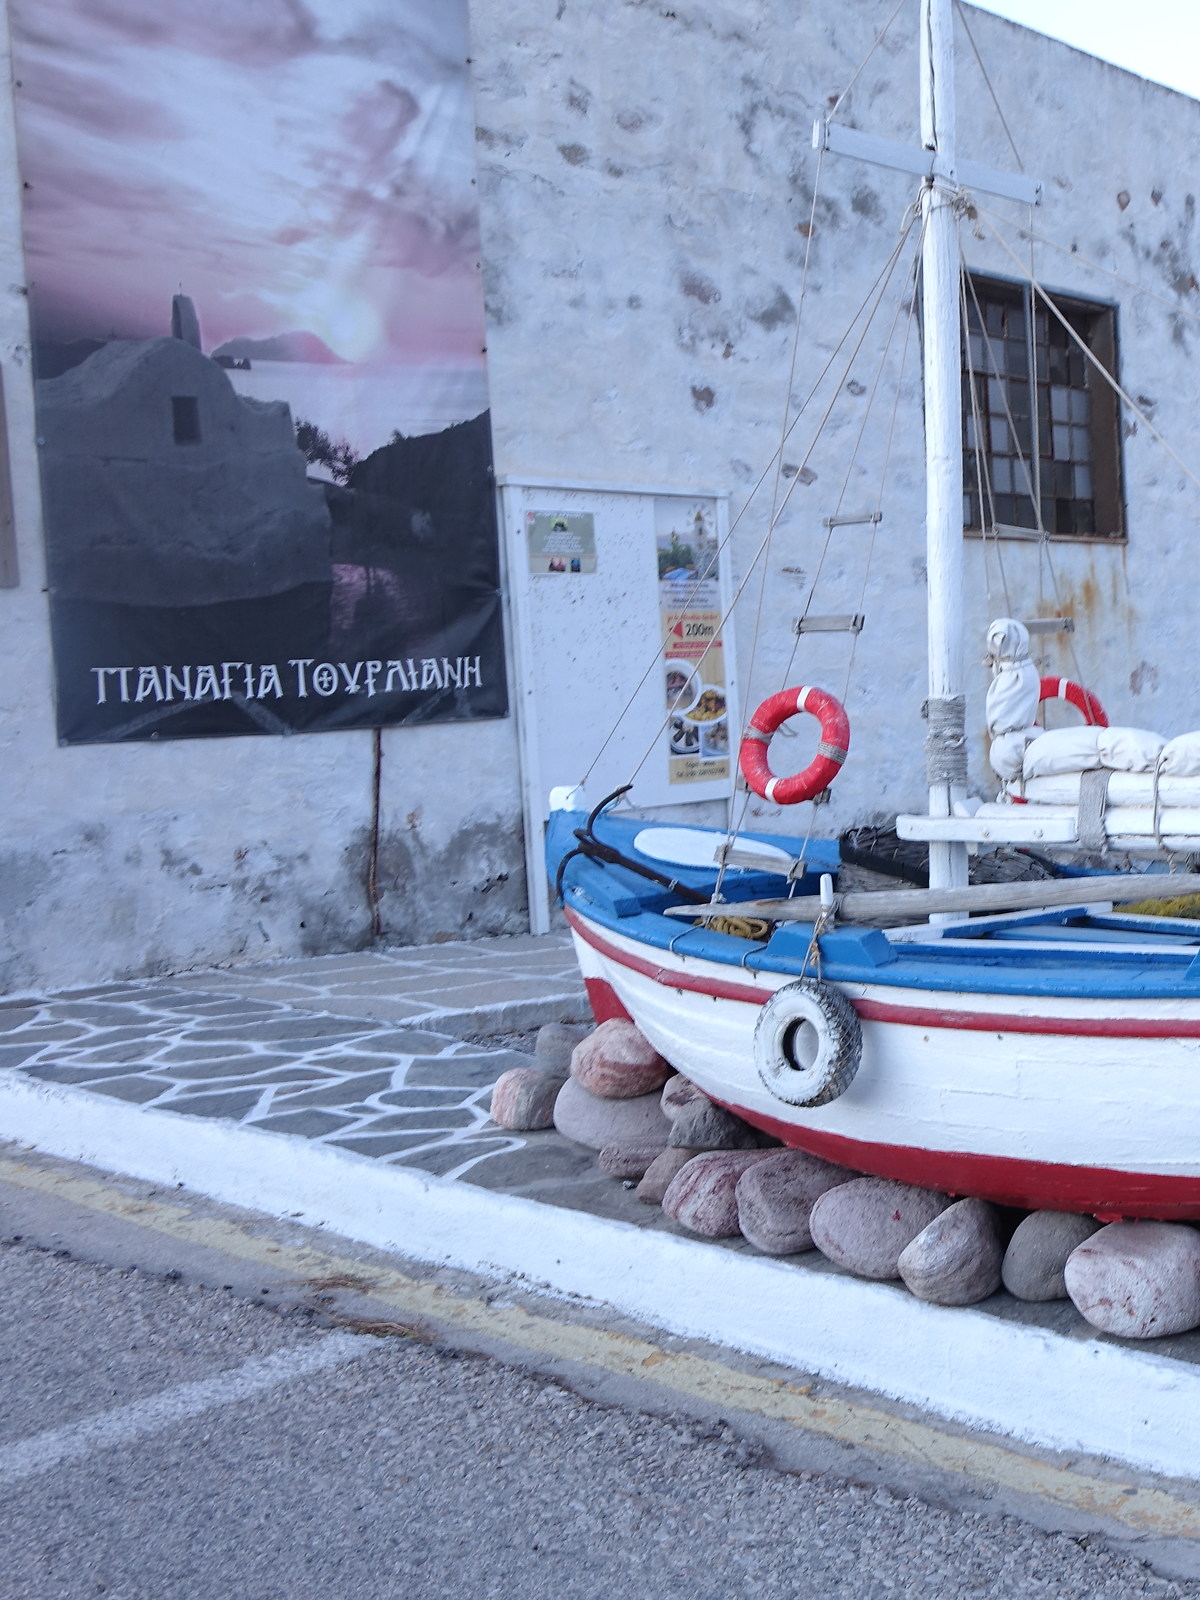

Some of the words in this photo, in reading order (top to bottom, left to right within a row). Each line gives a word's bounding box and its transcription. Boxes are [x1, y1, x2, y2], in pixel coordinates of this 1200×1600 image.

[685, 623, 714, 637] 200m
[90, 661, 284, 705] ΠΑΝΑΓΙΑ
[288, 655, 483, 698] ΤΟΥΡΛΙΑΝΗ
